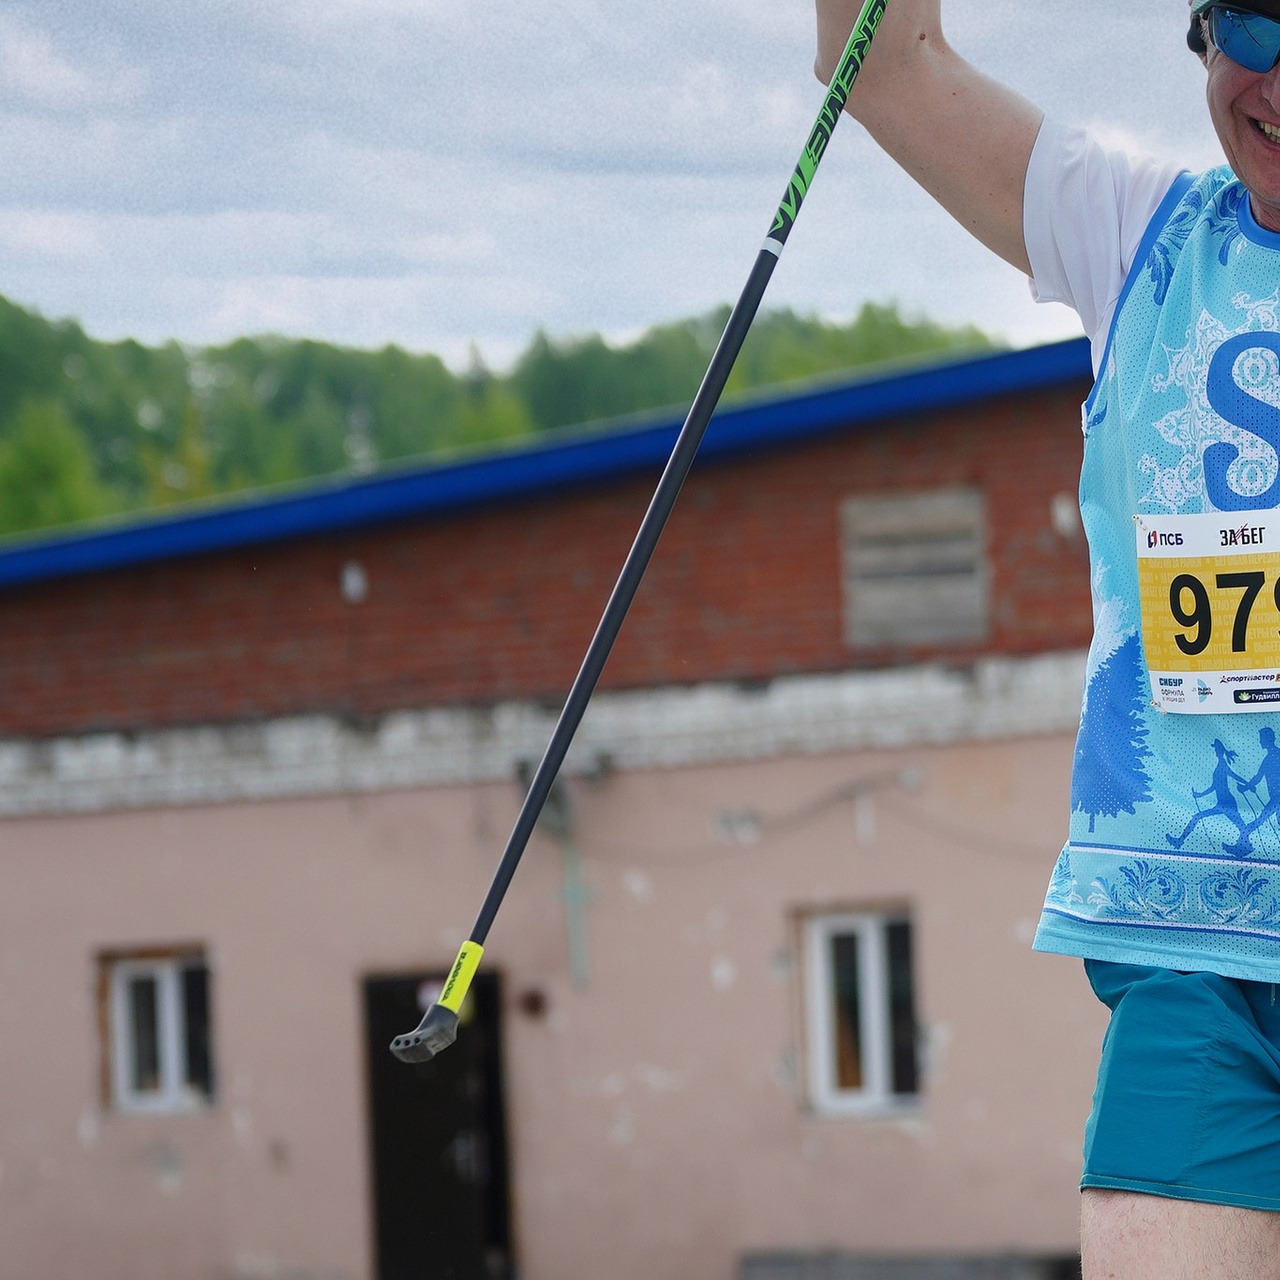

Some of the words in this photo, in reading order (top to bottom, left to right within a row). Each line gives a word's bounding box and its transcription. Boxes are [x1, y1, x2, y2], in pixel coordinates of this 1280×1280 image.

[1160, 533, 1184, 546] ПСБ
[1220, 526, 1266, 546] ЗАБЕГ
[1158, 677, 1184, 687] СИБУР
